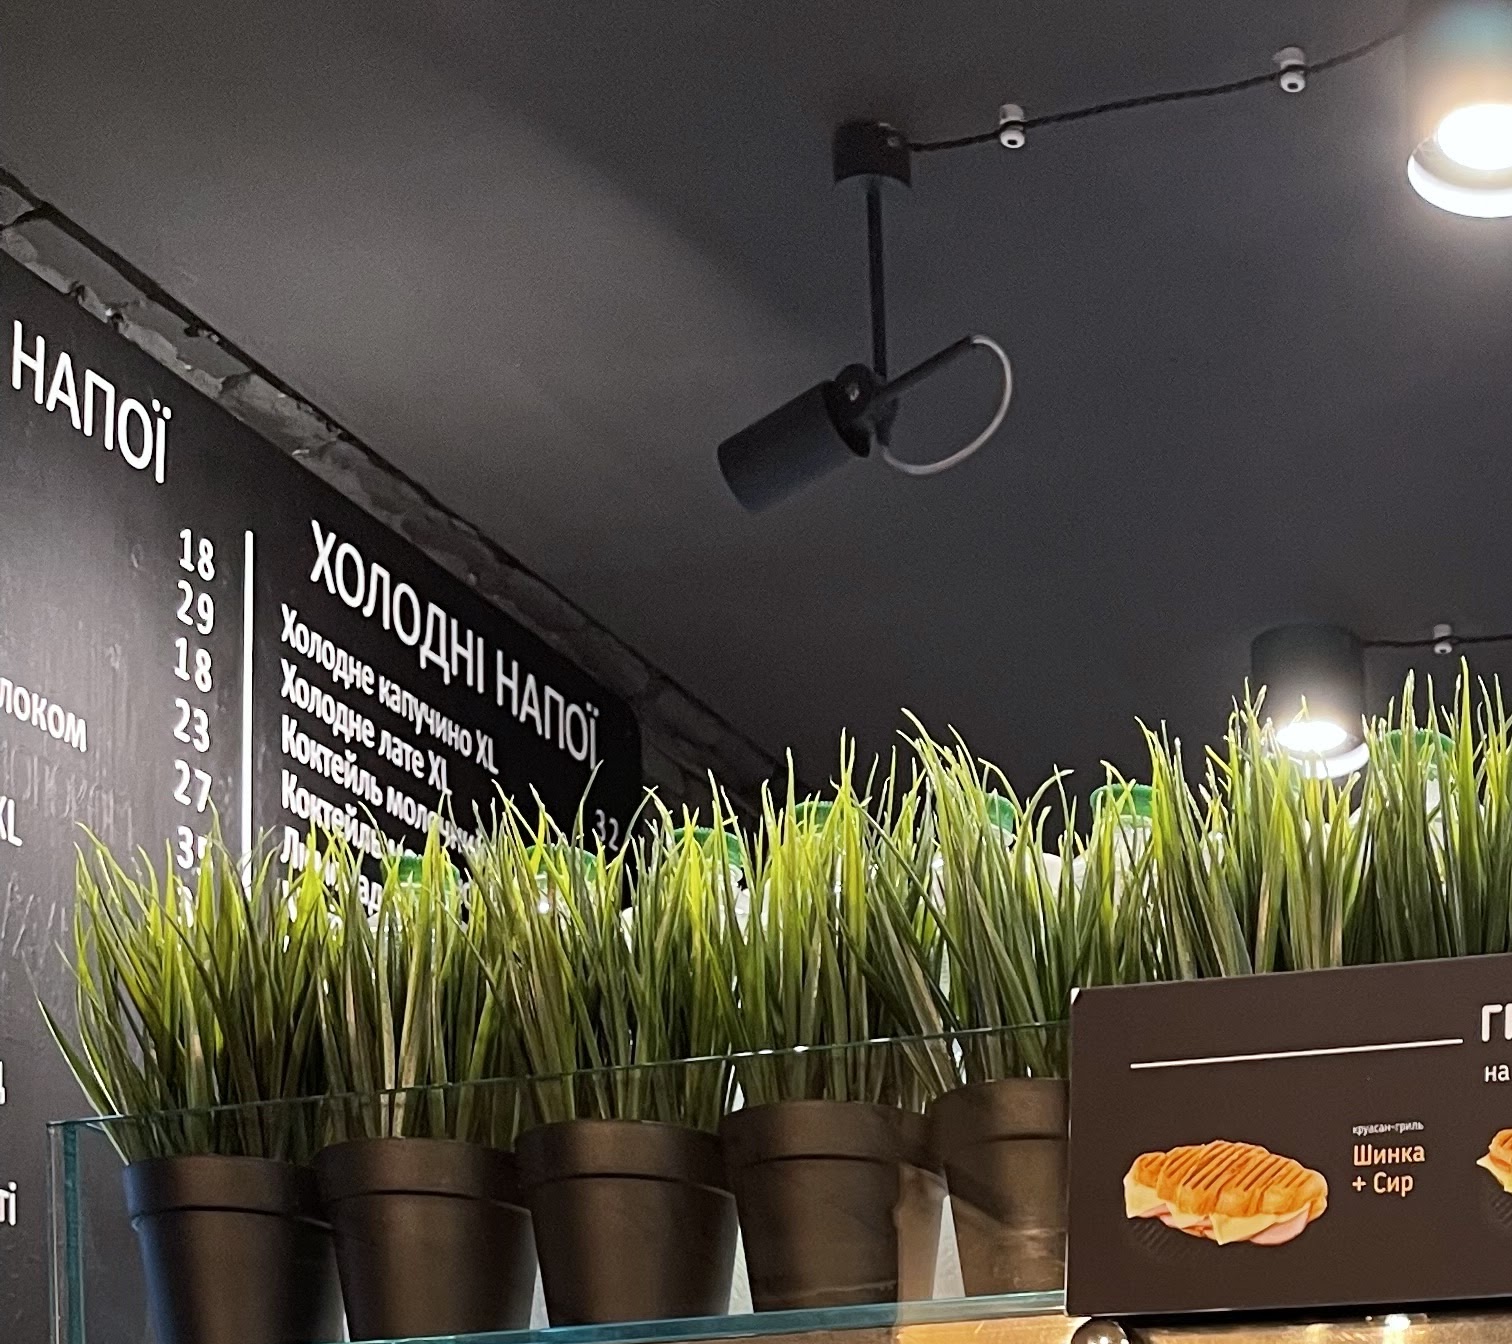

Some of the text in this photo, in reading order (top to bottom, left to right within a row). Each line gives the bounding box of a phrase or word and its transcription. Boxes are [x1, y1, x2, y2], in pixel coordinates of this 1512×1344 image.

[12, 319, 172, 484] НАПОЇ
[177, 528, 215, 581] 18
[175, 581, 215, 637] 29
[174, 637, 214, 693] 18
[310, 518, 600, 771] ХОЛОДНІ НАПОЇ
[280, 602, 500, 775] Холодне капучино XL
[173, 697, 210, 753] 23
[280, 658, 454, 796] Холодне лате XL
[173, 758, 212, 813] 27
[280, 713, 384, 807] Коктейль
[1484, 1064, 1510, 1083] на
[1352, 1121, 1425, 1137] круасан-гриль
[1353, 1141, 1426, 1167] Шинка
[1372, 1172, 1414, 1198] Сир
